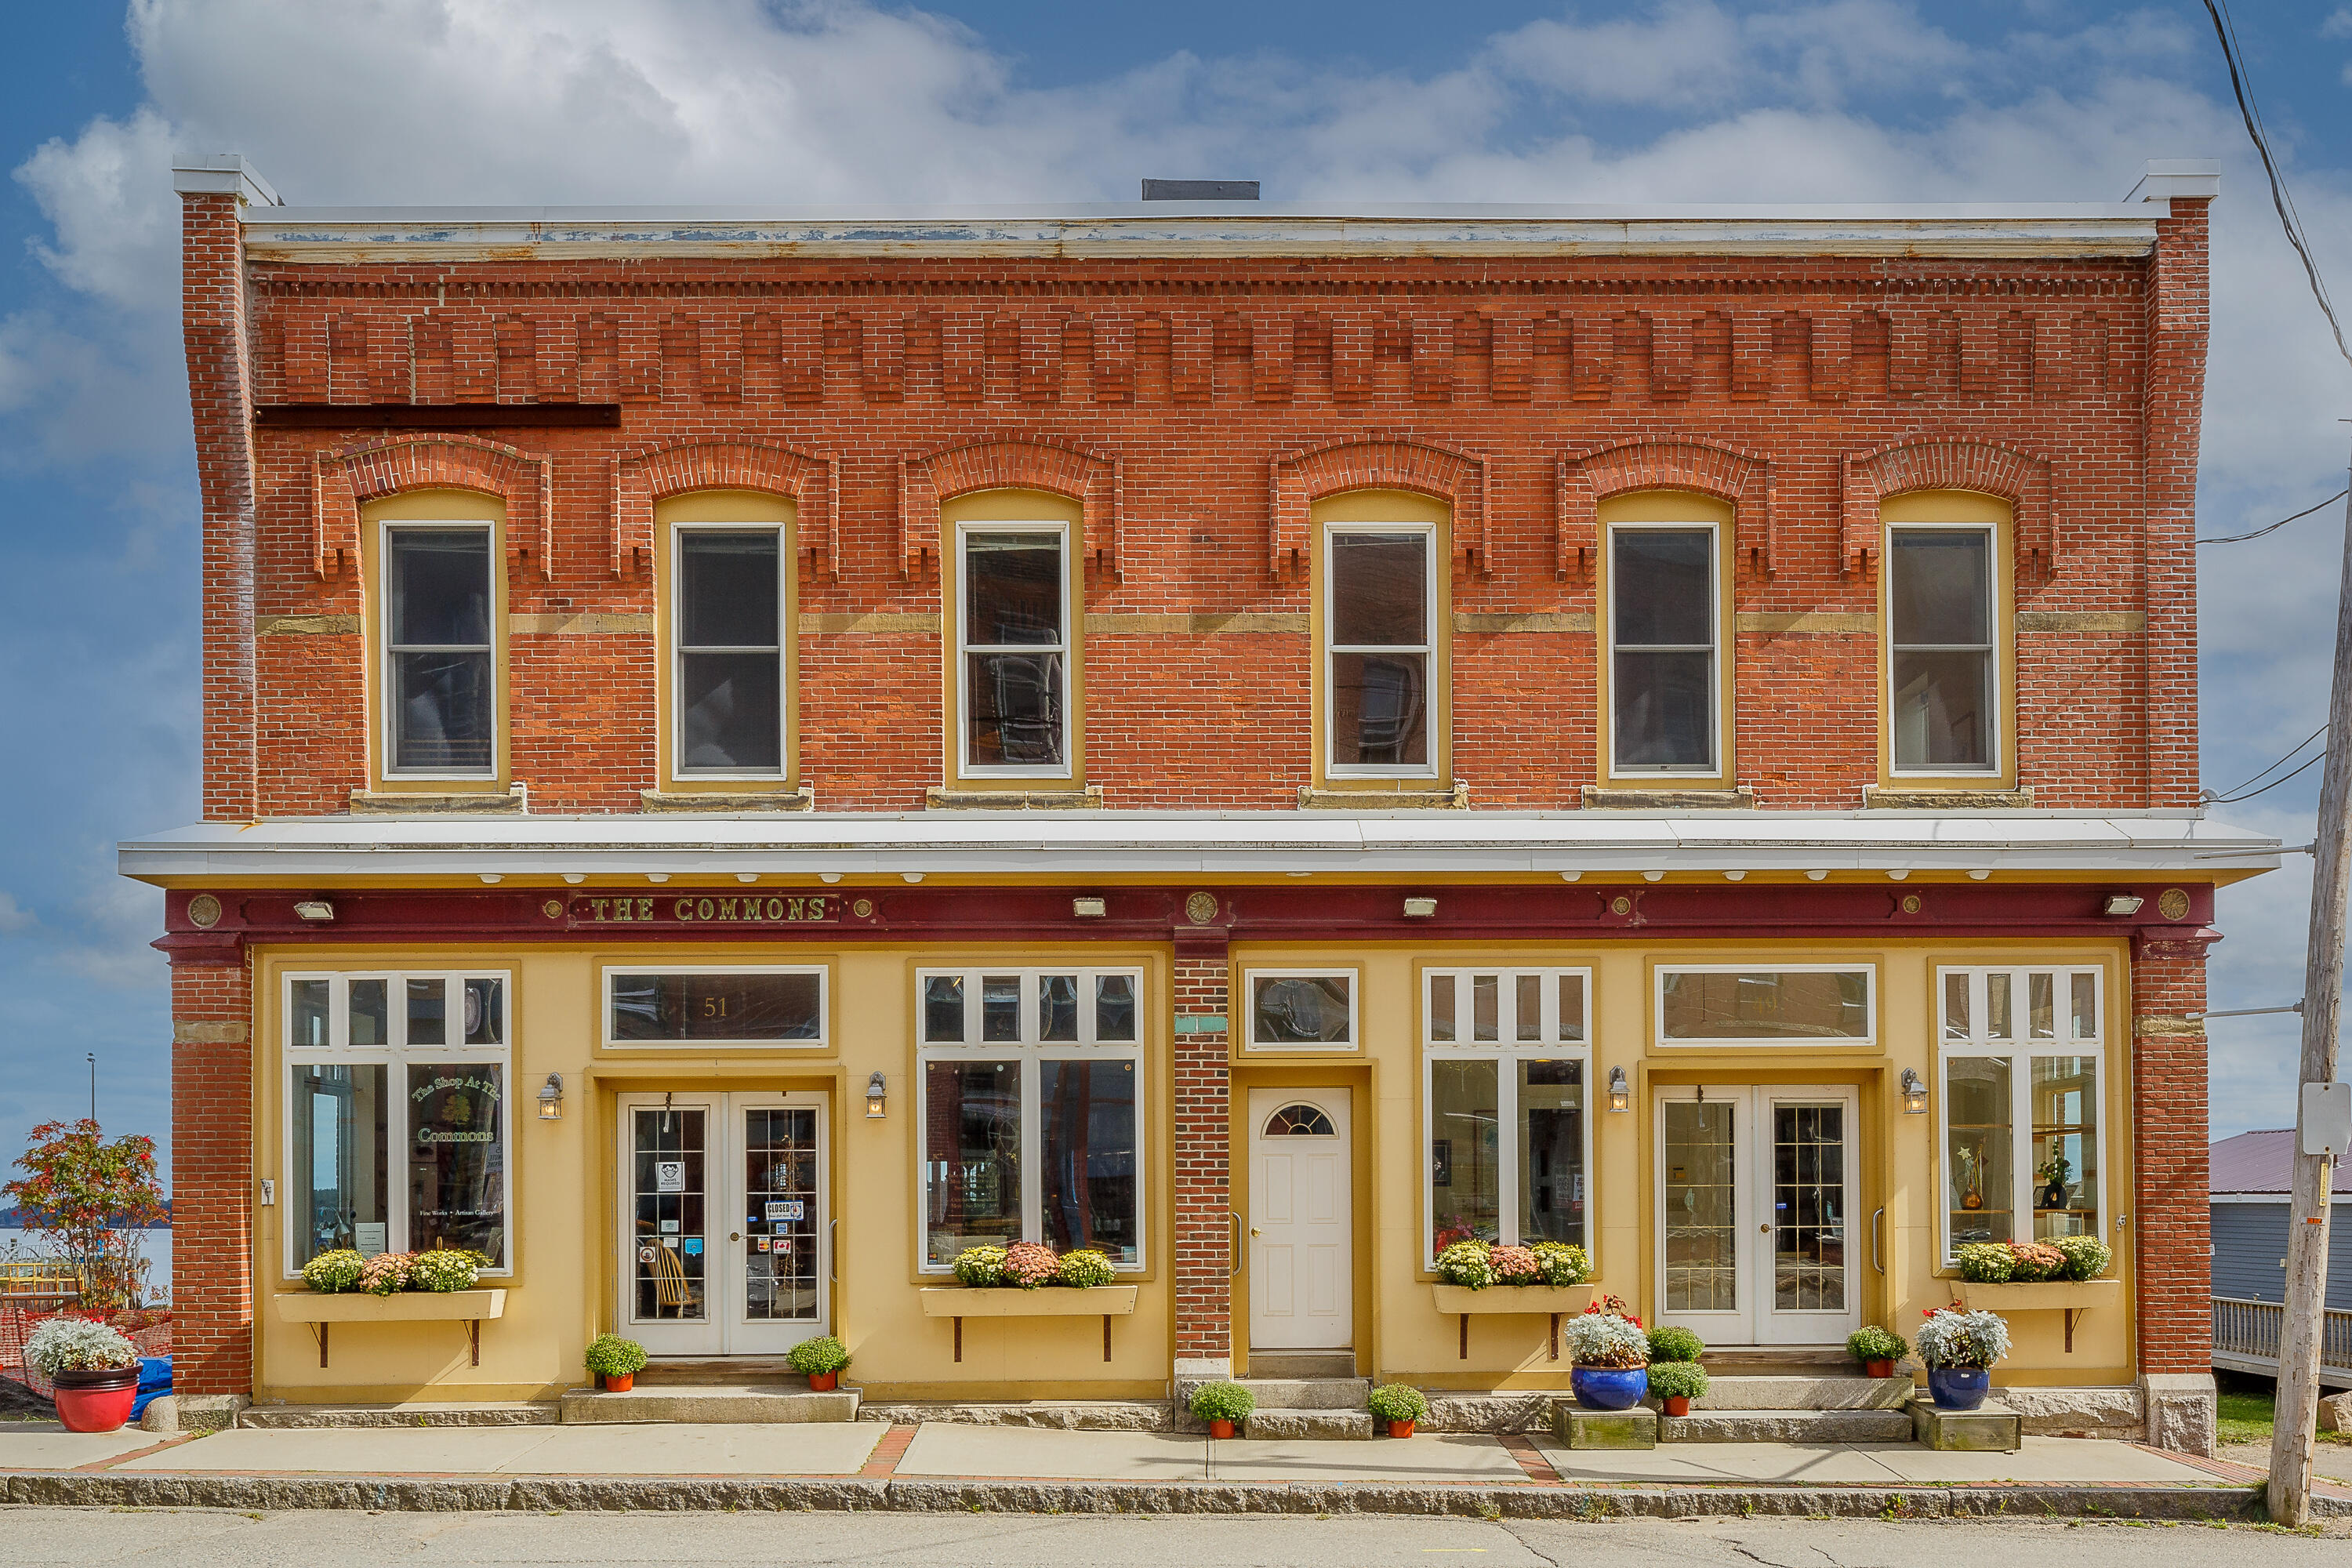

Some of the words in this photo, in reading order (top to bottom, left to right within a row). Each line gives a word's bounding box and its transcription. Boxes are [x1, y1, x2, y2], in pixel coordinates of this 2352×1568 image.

[591, 898, 654, 921] THE
[674, 898, 826, 921] COMMONS
[704, 997, 727, 1017] 51
[412, 1085, 434, 1102] The
[434, 1076, 463, 1090] Shop
[464, 1076, 481, 1088] At
[482, 1080, 502, 1101] The
[418, 1127, 494, 1142] Commons
[474, 1209, 494, 1218] Gallery
[768, 1204, 789, 1213] CLOSED
